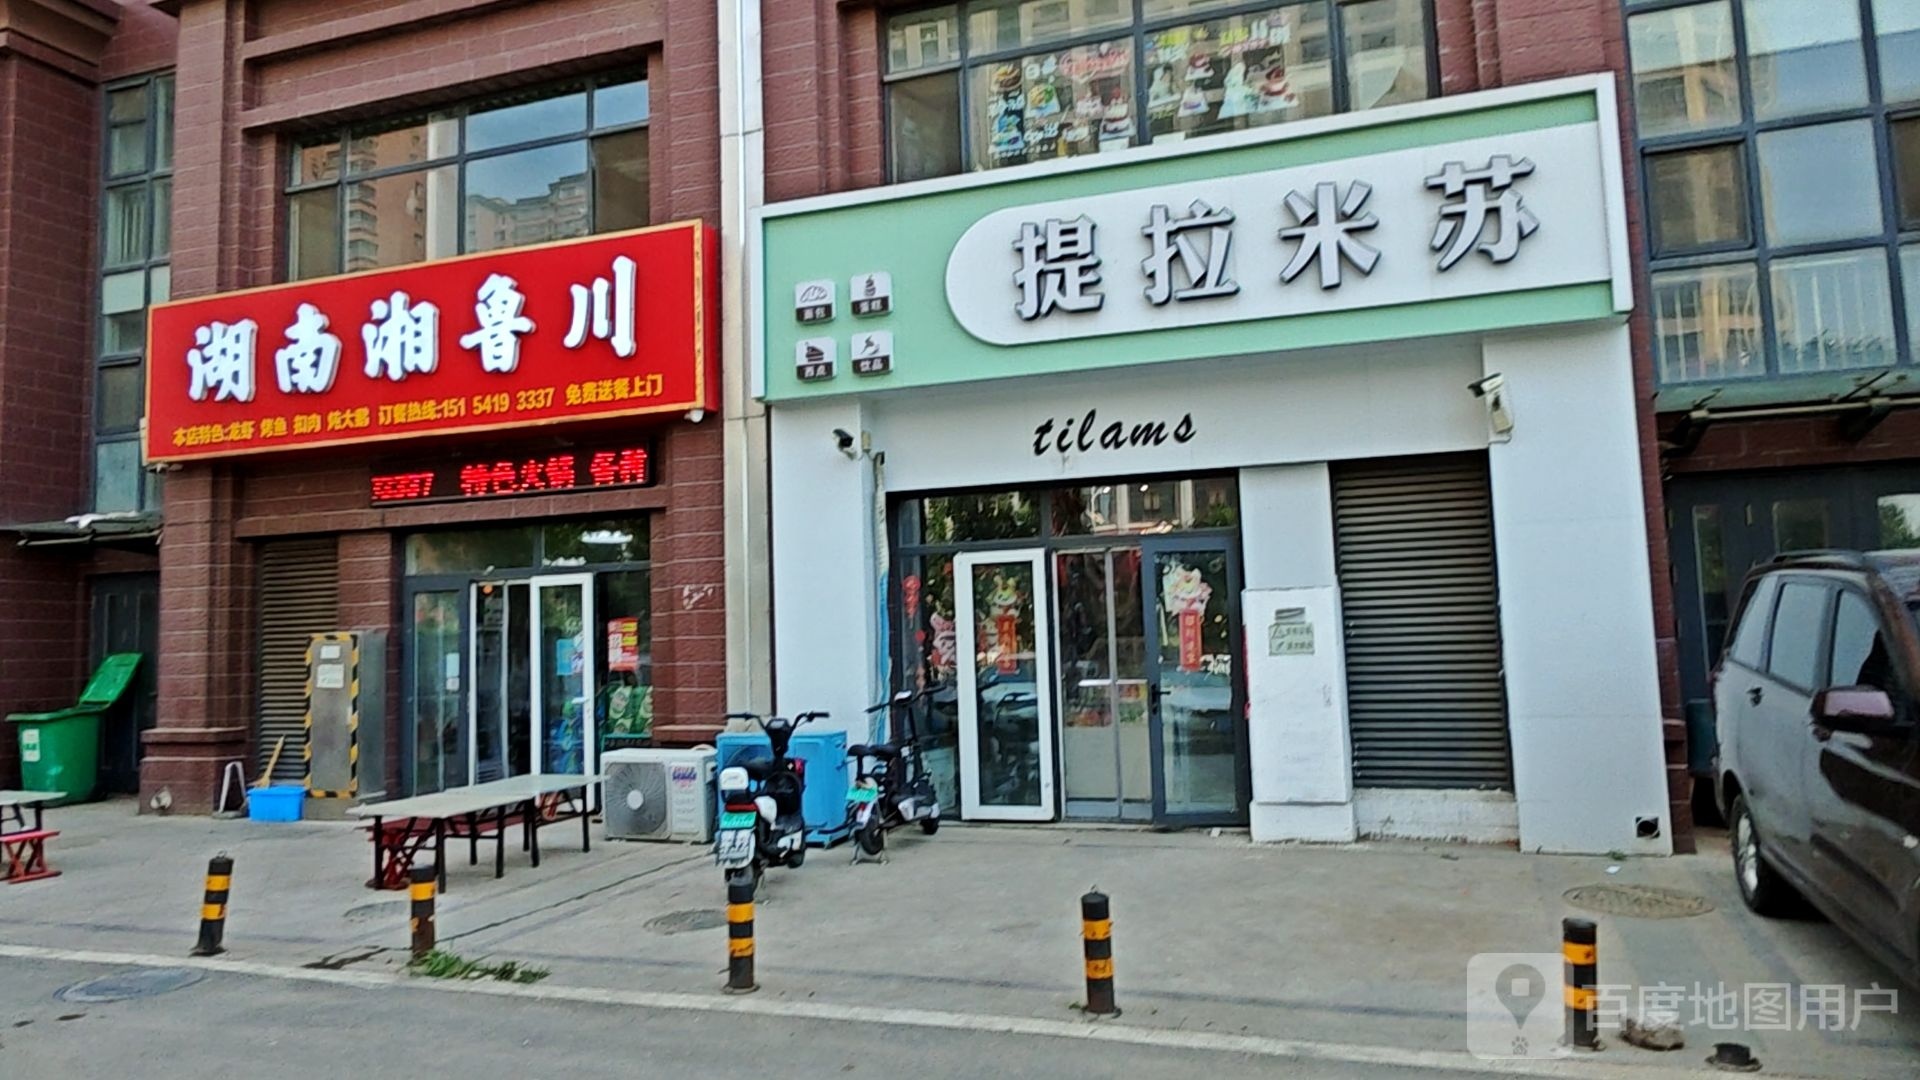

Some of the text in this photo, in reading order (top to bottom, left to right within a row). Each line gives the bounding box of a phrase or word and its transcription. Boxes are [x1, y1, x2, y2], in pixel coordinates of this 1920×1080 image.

[1012, 154, 1540, 322] 提拉米苏
[186, 254, 637, 403] 湖南湘鲁川
[473, 390, 510, 416] 5419
[516, 387, 555, 412] 3337
[565, 374, 664, 407] 免费送餐上门
[1033, 408, 1197, 457] tilams
